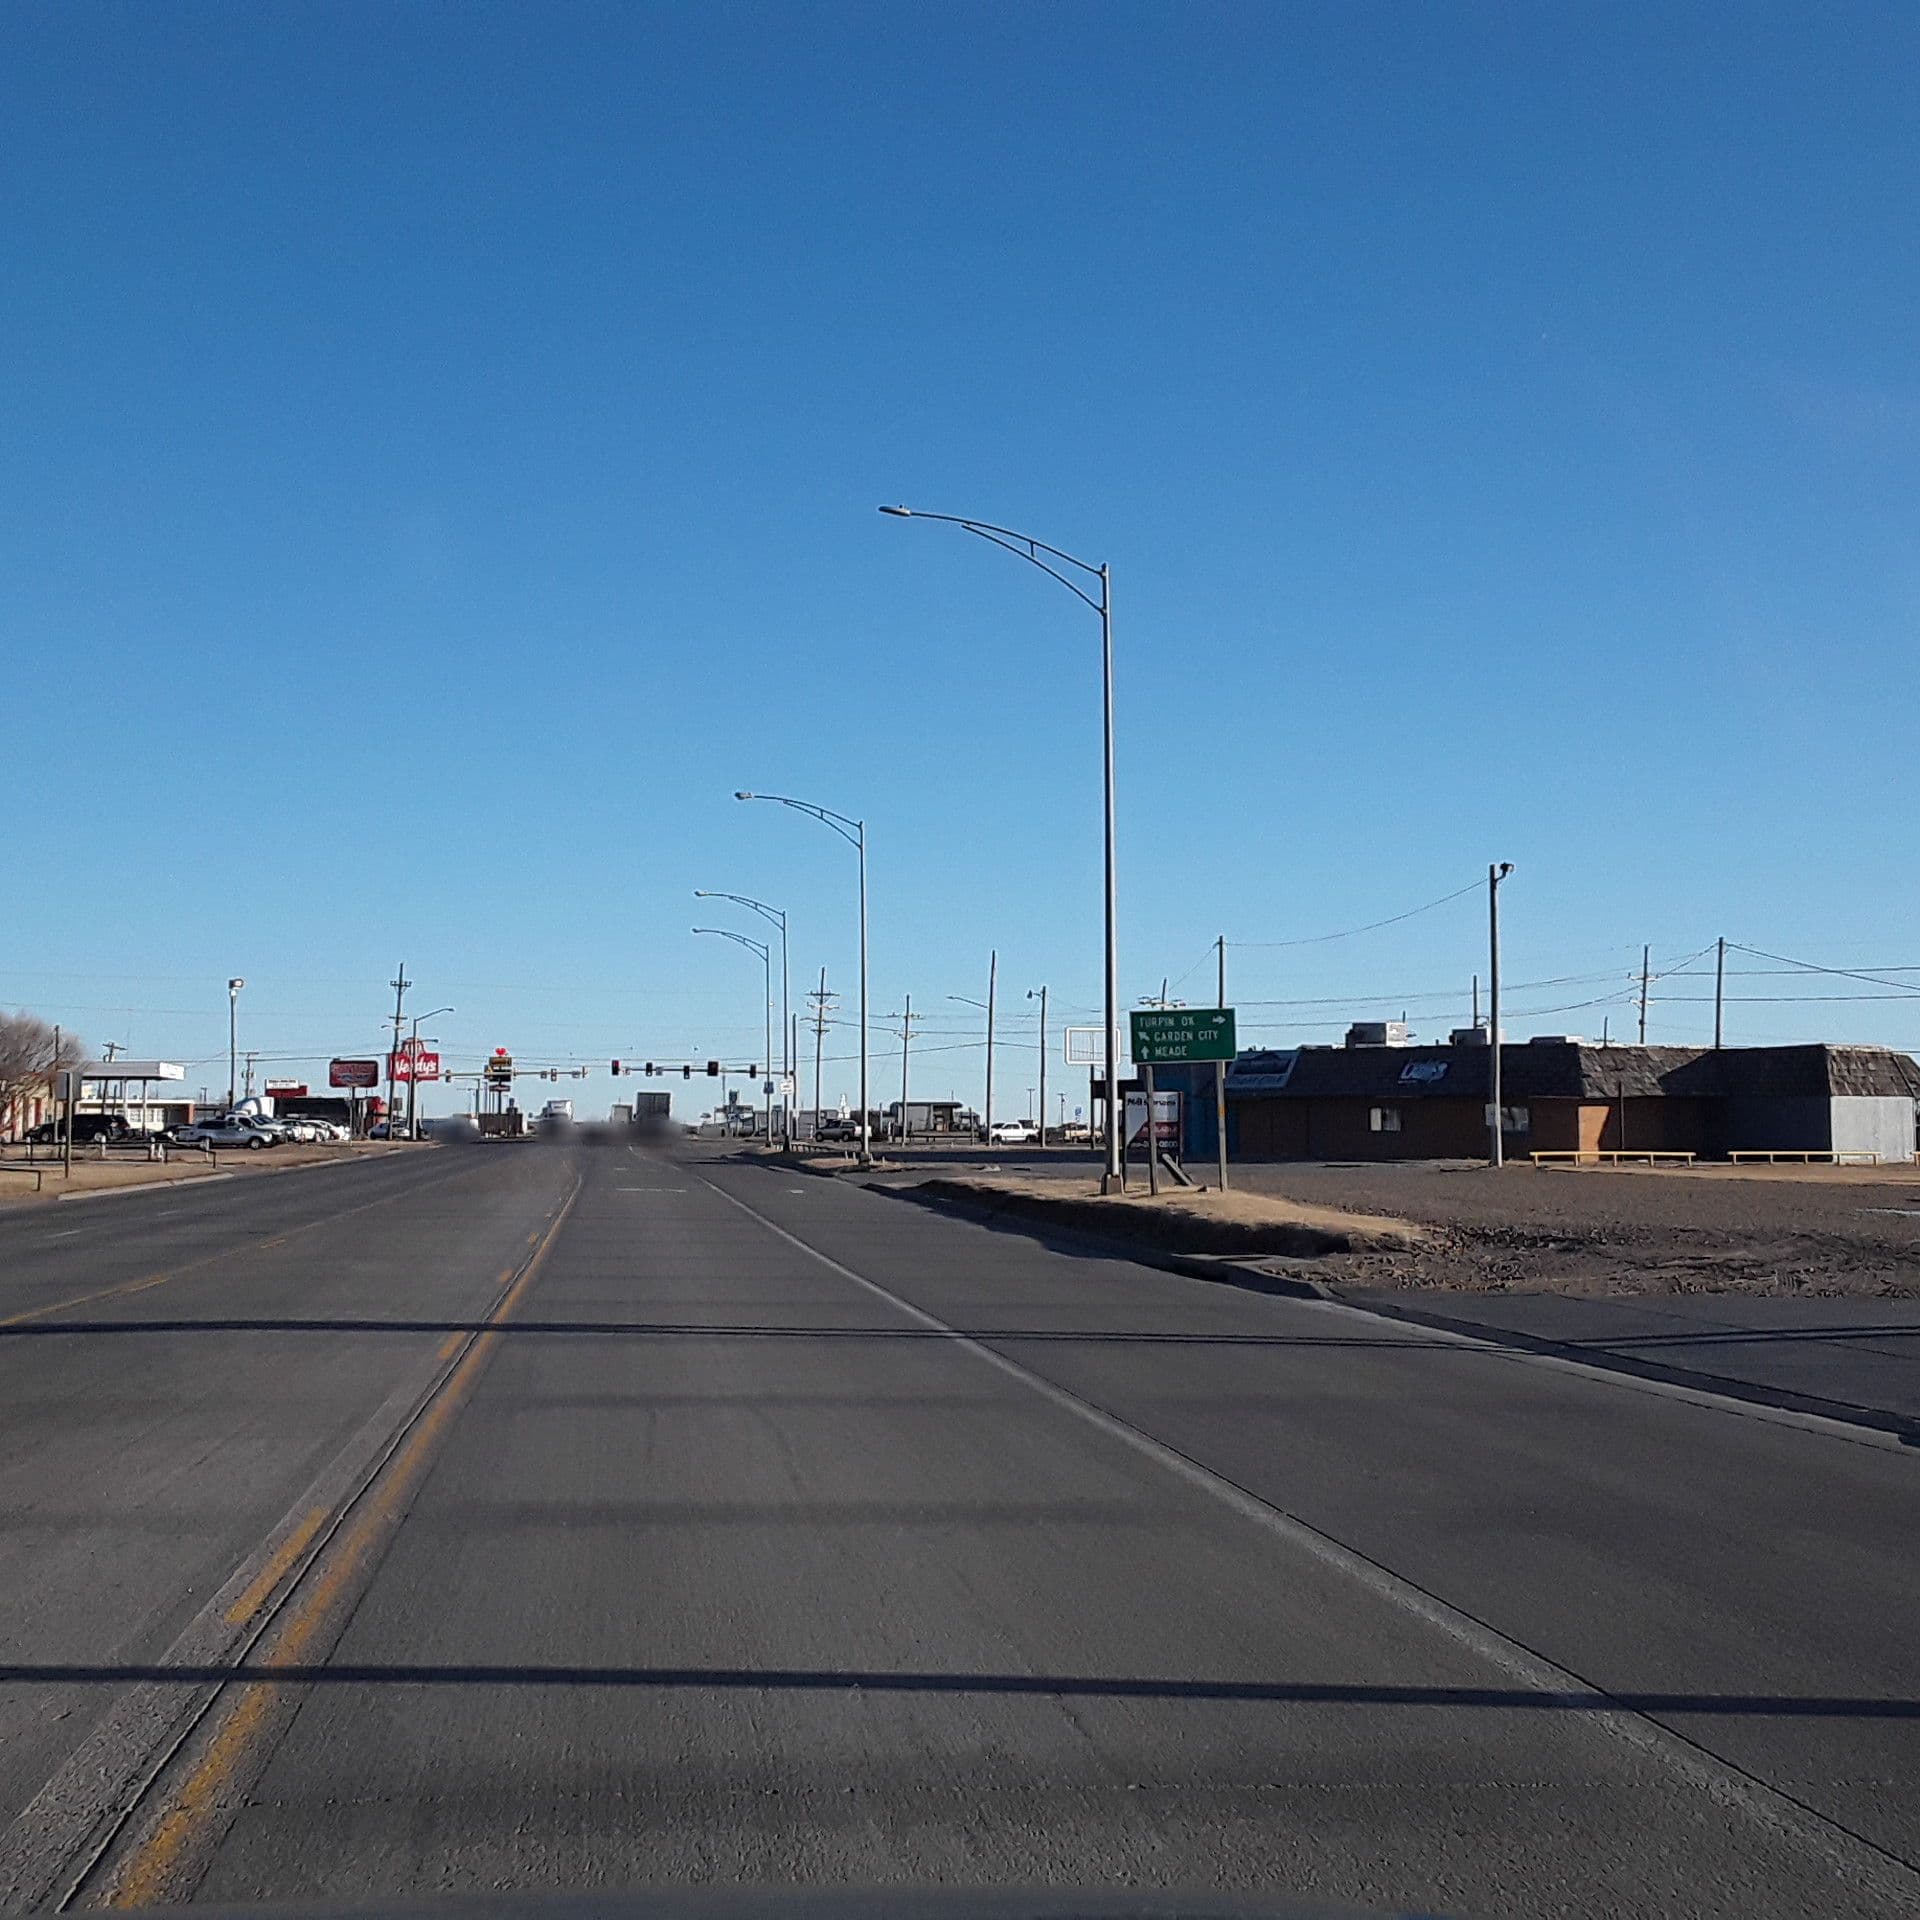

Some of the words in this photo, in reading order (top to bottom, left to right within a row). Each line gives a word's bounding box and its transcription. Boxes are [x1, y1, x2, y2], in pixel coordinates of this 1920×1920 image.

[1140, 1016, 1175, 1028] TURPIN
[1181, 1016, 1196, 1027] OK
[1154, 1030, 1194, 1042] GARDEN
[1198, 1029, 1219, 1041] CITY
[1154, 1045, 1188, 1057] MEADE
